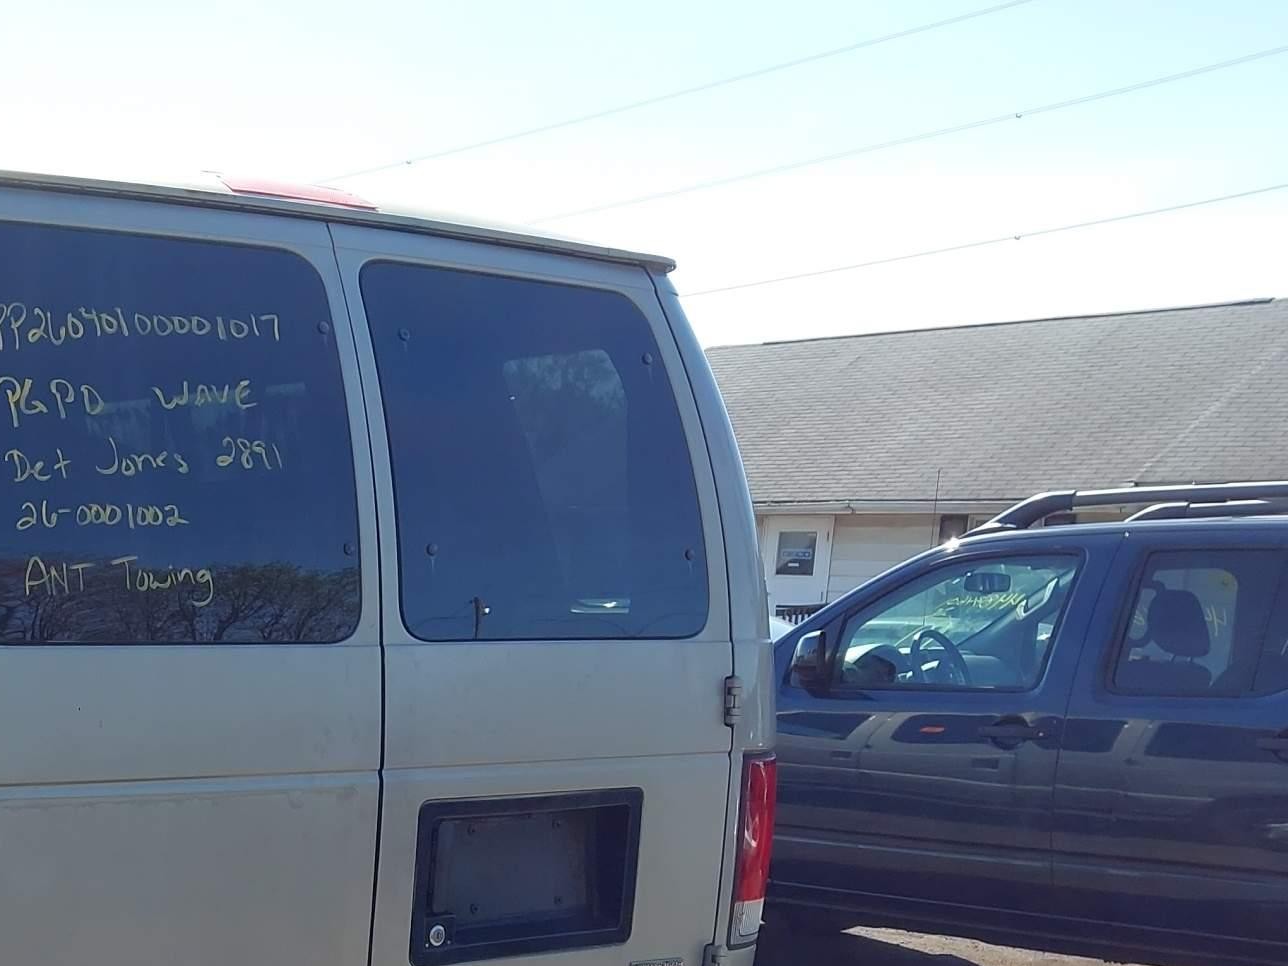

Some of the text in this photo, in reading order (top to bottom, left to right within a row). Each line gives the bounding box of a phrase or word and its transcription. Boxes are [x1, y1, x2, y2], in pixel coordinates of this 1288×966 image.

[4, 437, 283, 482] Det Jones 2891
[15, 501, 191, 530] 26-0001002
[24, 555, 214, 608] ANT Towing
